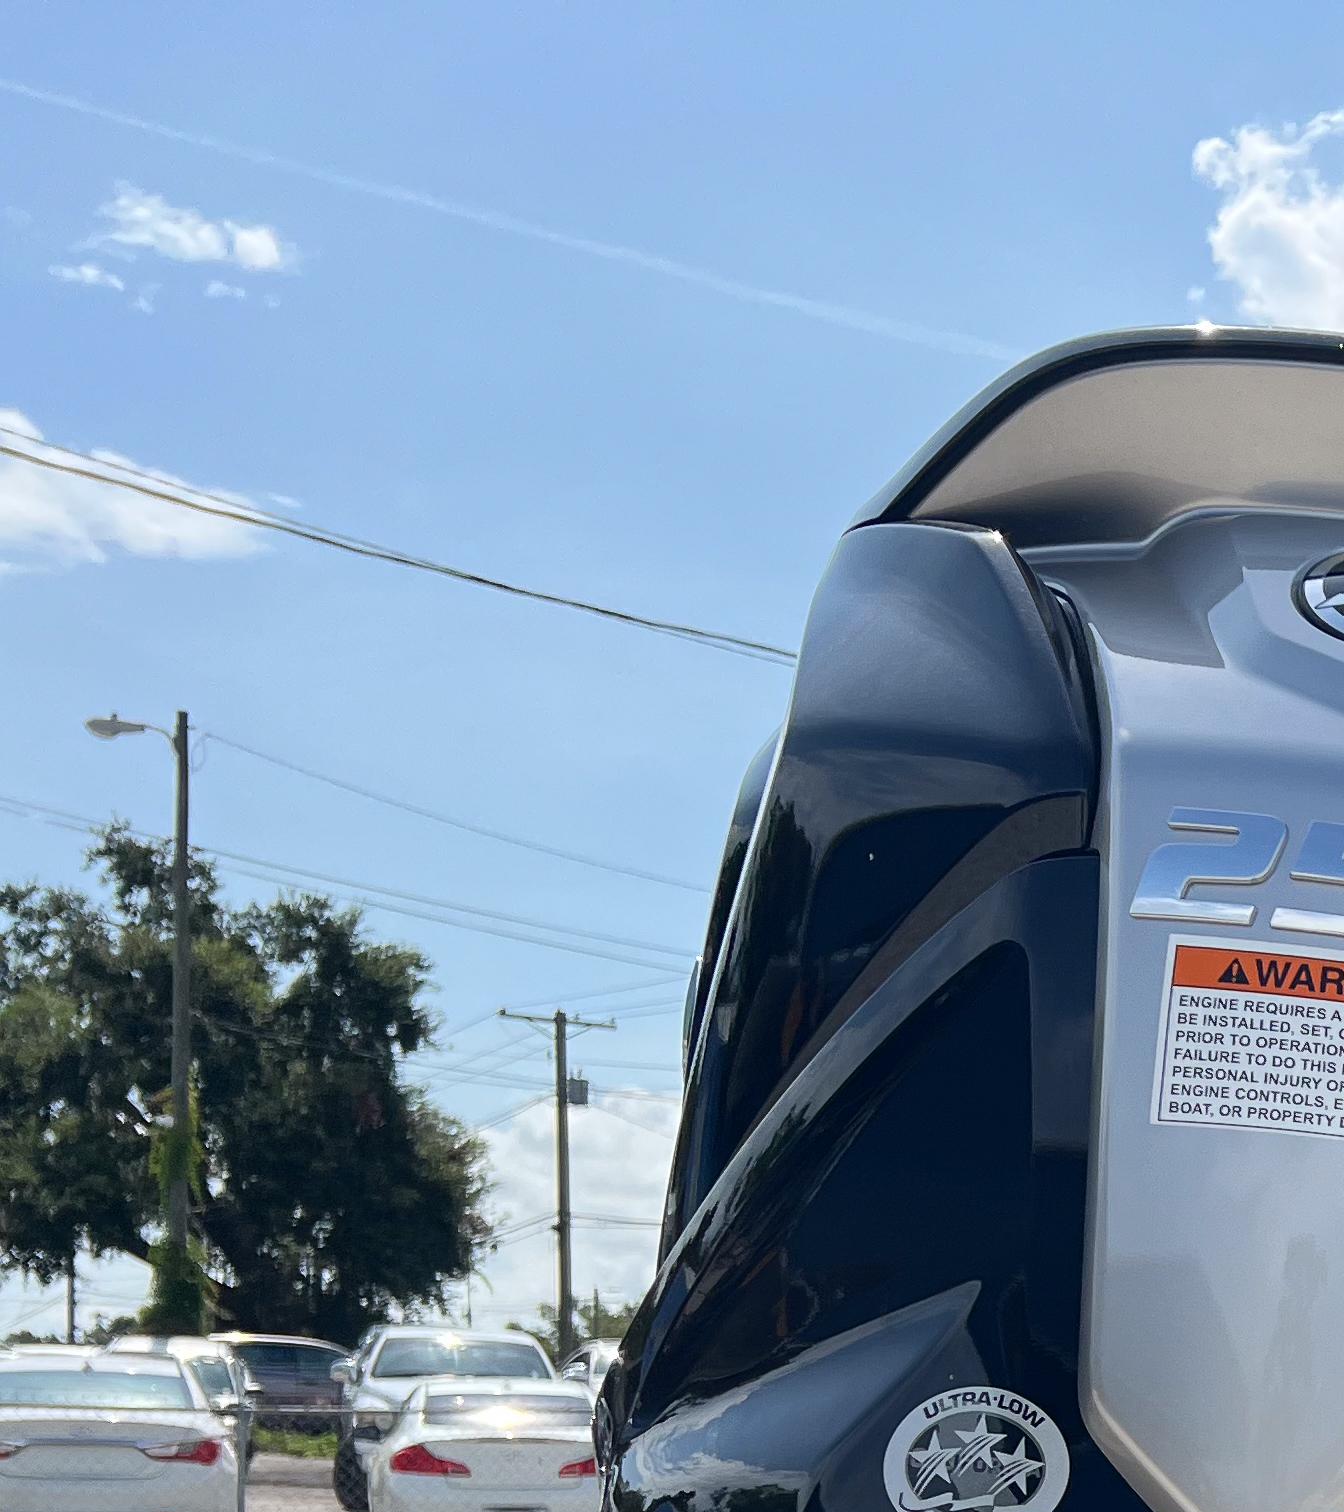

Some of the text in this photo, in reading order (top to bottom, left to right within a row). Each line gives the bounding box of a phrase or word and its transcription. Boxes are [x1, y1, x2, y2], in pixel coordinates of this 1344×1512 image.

[1178, 994, 1239, 1011] ENGINE
[1243, 1000, 1327, 1020] REQUIRES
[1330, 1010, 1342, 1022] A
[1175, 1030, 1225, 1045] PRIOR
[1229, 1033, 1251, 1047] TO
[1177, 1012, 1198, 1025] BE
[1202, 1015, 1295, 1036] INSTALLED,
[1300, 1023, 1334, 1040] SET,
[1173, 1047, 1241, 1064] FAILURE
[1245, 1052, 1267, 1066] TO
[1272, 1055, 1296, 1069] DO
[1300, 1058, 1337, 1074] THIS
[1172, 1065, 1259, 1084] PERSONAL
[1263, 1072, 1323, 1090] INJURY
[1170, 1083, 1230, 1099] ENGINE
[1235, 1088, 1329, 1111] CONTROLS,
[1168, 1101, 1215, 1117] BOAT,
[1219, 1104, 1242, 1118] OR
[1247, 1106, 1336, 1127] PROPERTY
